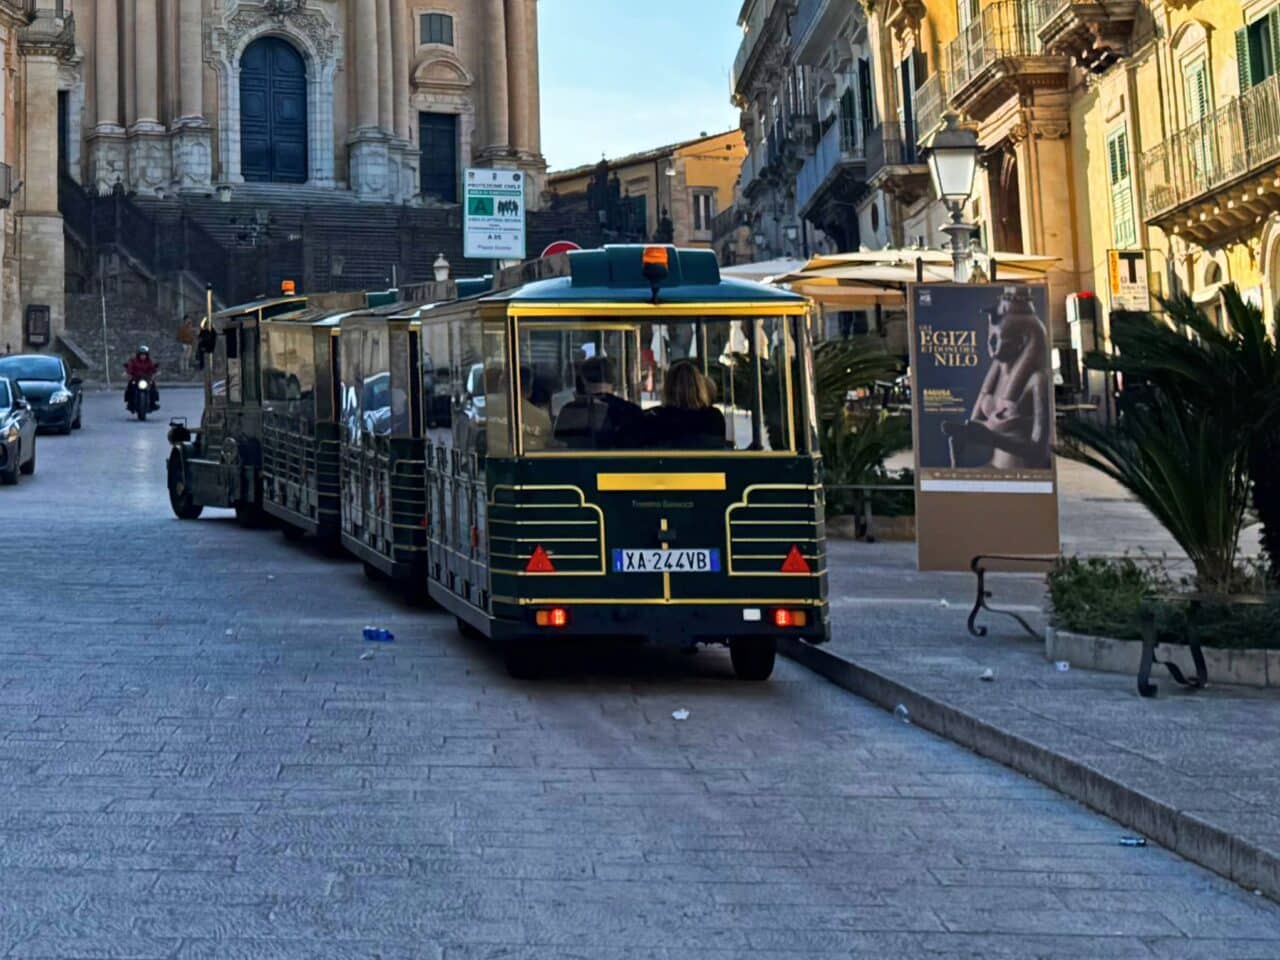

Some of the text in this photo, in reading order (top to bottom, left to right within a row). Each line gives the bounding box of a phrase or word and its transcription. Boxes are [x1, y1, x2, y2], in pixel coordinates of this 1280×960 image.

[474, 199, 488, 214] A
[1118, 251, 1144, 284] T
[920, 330, 977, 346] EGIZI
[934, 353, 978, 367] NILO
